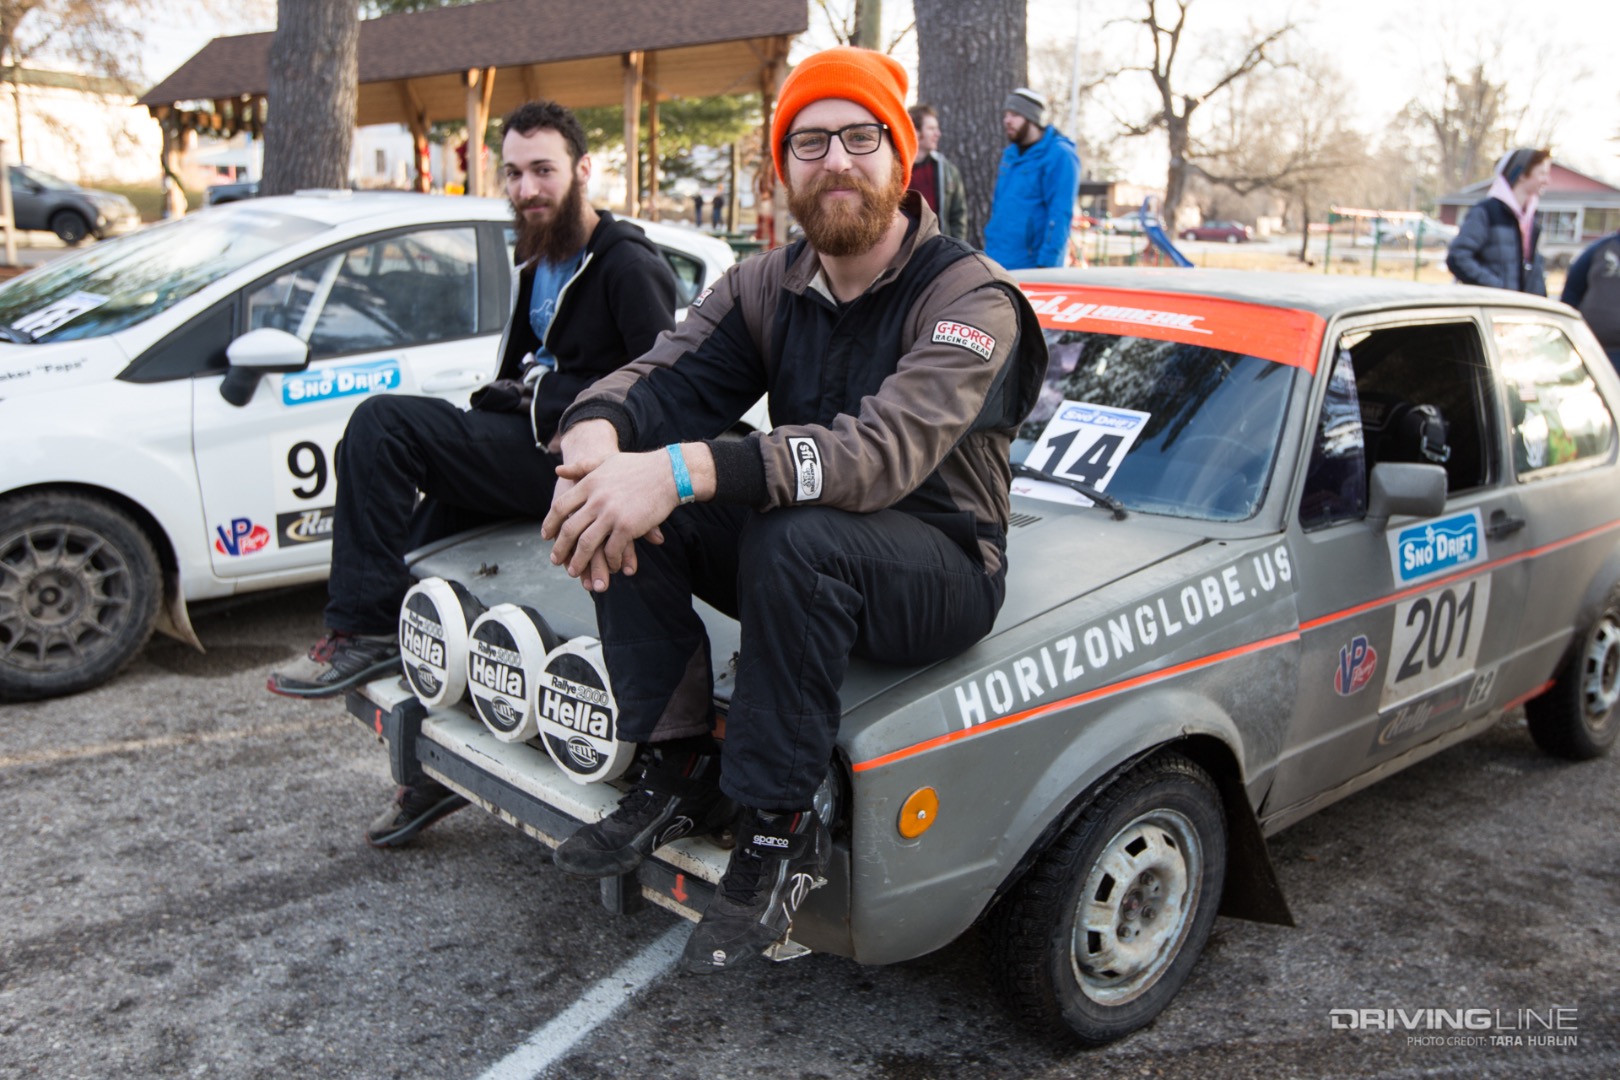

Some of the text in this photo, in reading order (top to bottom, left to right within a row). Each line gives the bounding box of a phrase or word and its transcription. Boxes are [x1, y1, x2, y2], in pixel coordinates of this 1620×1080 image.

[935, 334, 990, 357] RACING GEAR
[937, 322, 994, 351] G-FORCE
[799, 443, 815, 460] sfi
[1041, 428, 1125, 486] 14
[217, 518, 252, 556] VP
[1404, 533, 1474, 571] SNO DRIFT
[404, 622, 443, 668] Hella
[954, 545, 1293, 729] HORIZONGLOBE.US
[1395, 581, 1476, 683] 201
[472, 654, 522, 698] Hella
[1340, 636, 1368, 694] VP
[552, 676, 609, 707] Rallye 2000
[542, 689, 608, 739] Hella
[568, 743, 598, 762] HELLA
[753, 834, 789, 845] sparco
